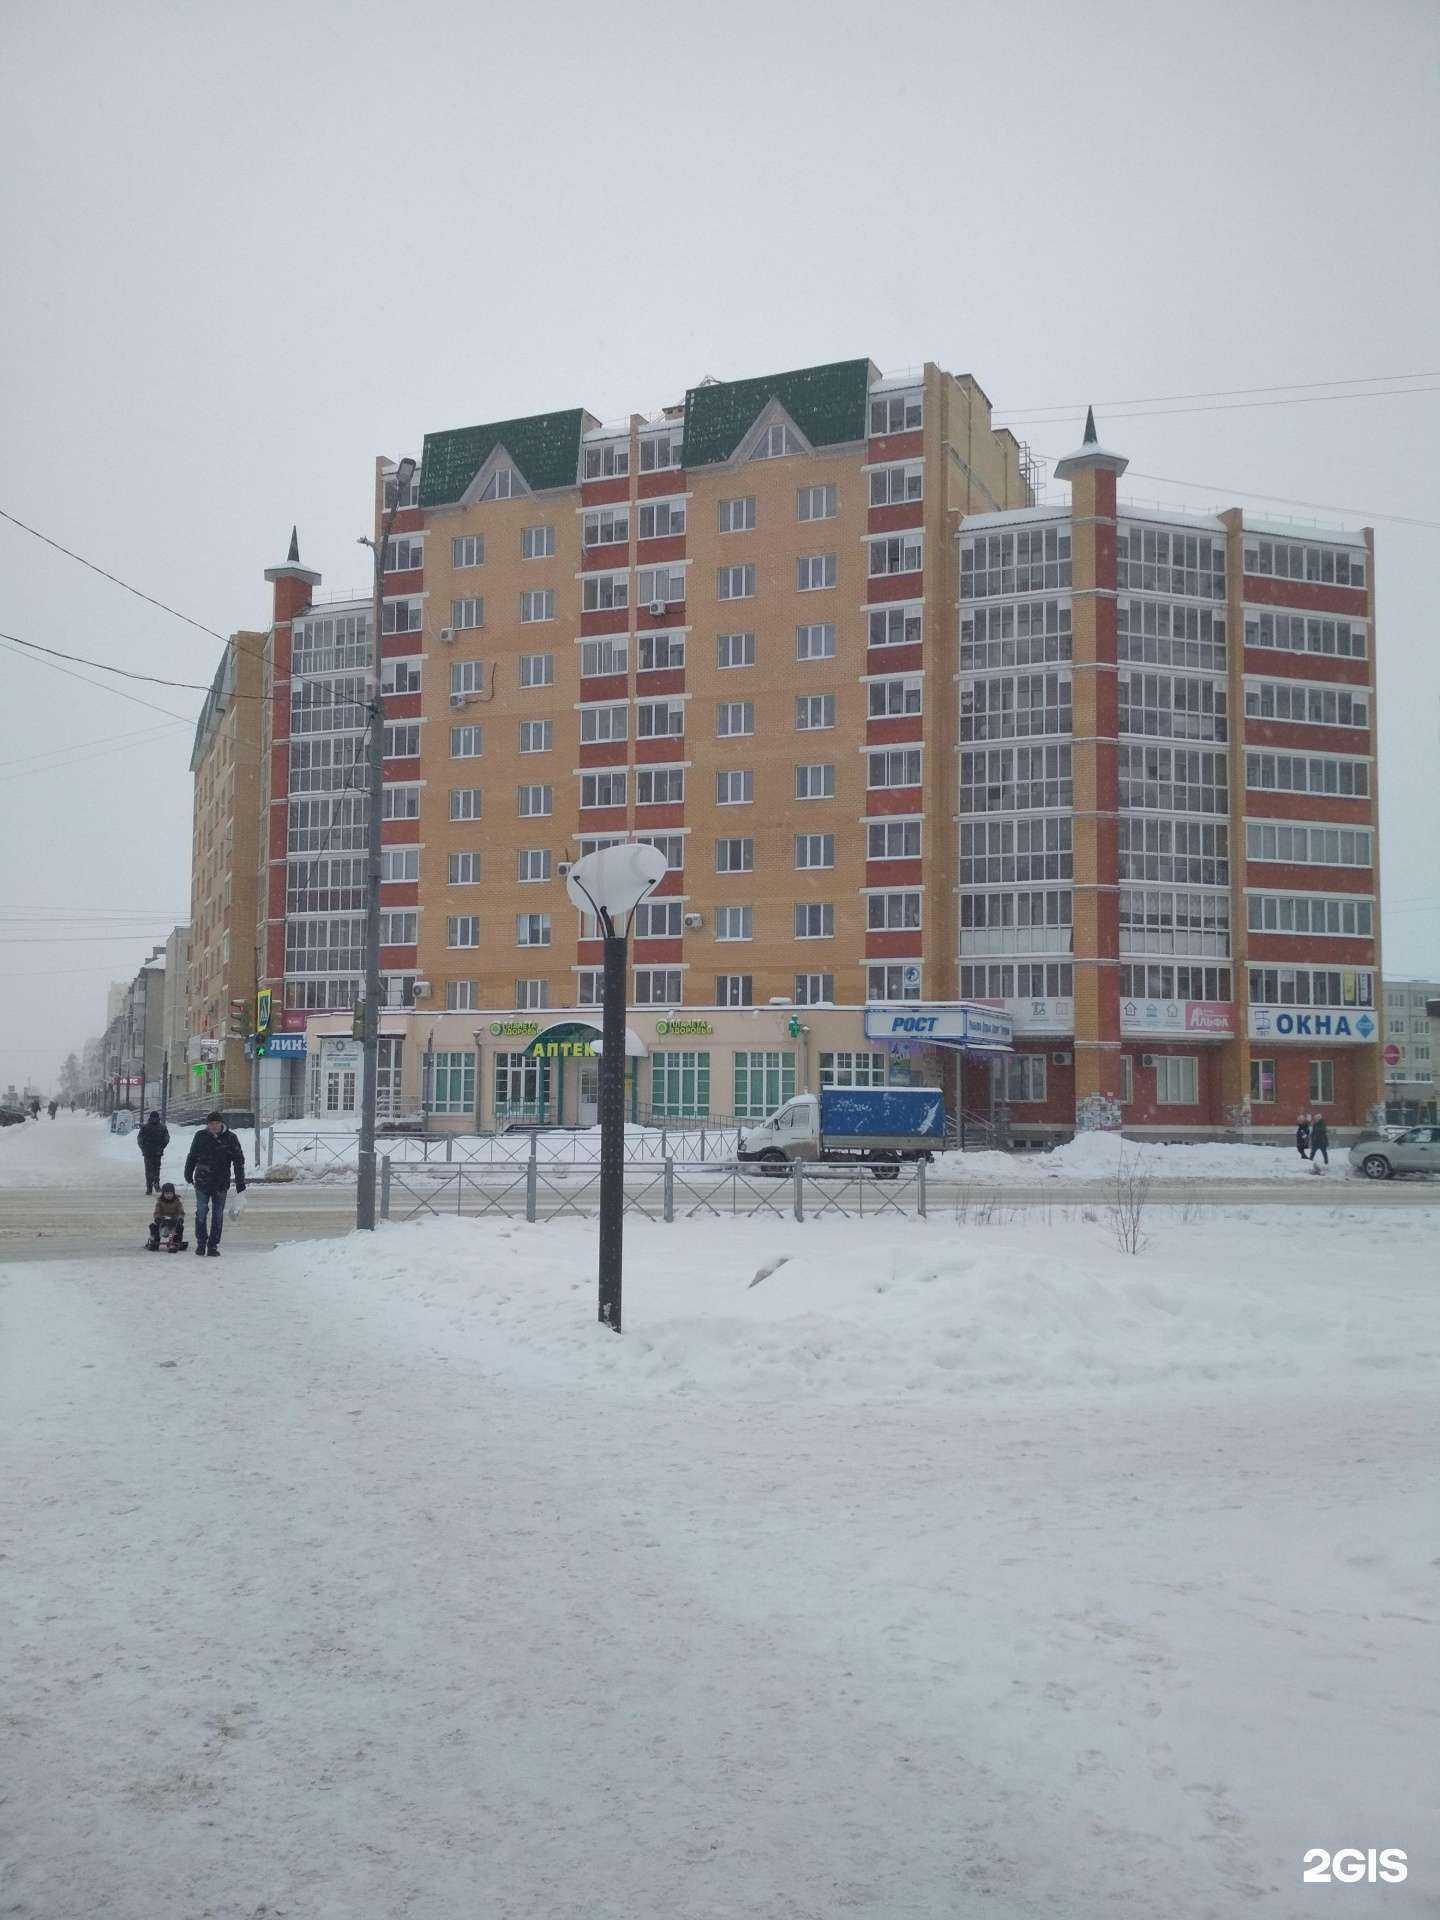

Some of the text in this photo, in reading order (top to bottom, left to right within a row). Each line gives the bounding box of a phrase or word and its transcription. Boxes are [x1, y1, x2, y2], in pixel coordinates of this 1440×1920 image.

[891, 1016, 939, 1032] РОСТ
[1276, 1013, 1352, 1036] ОКНА
[533, 1043, 597, 1057] АПТЕК
